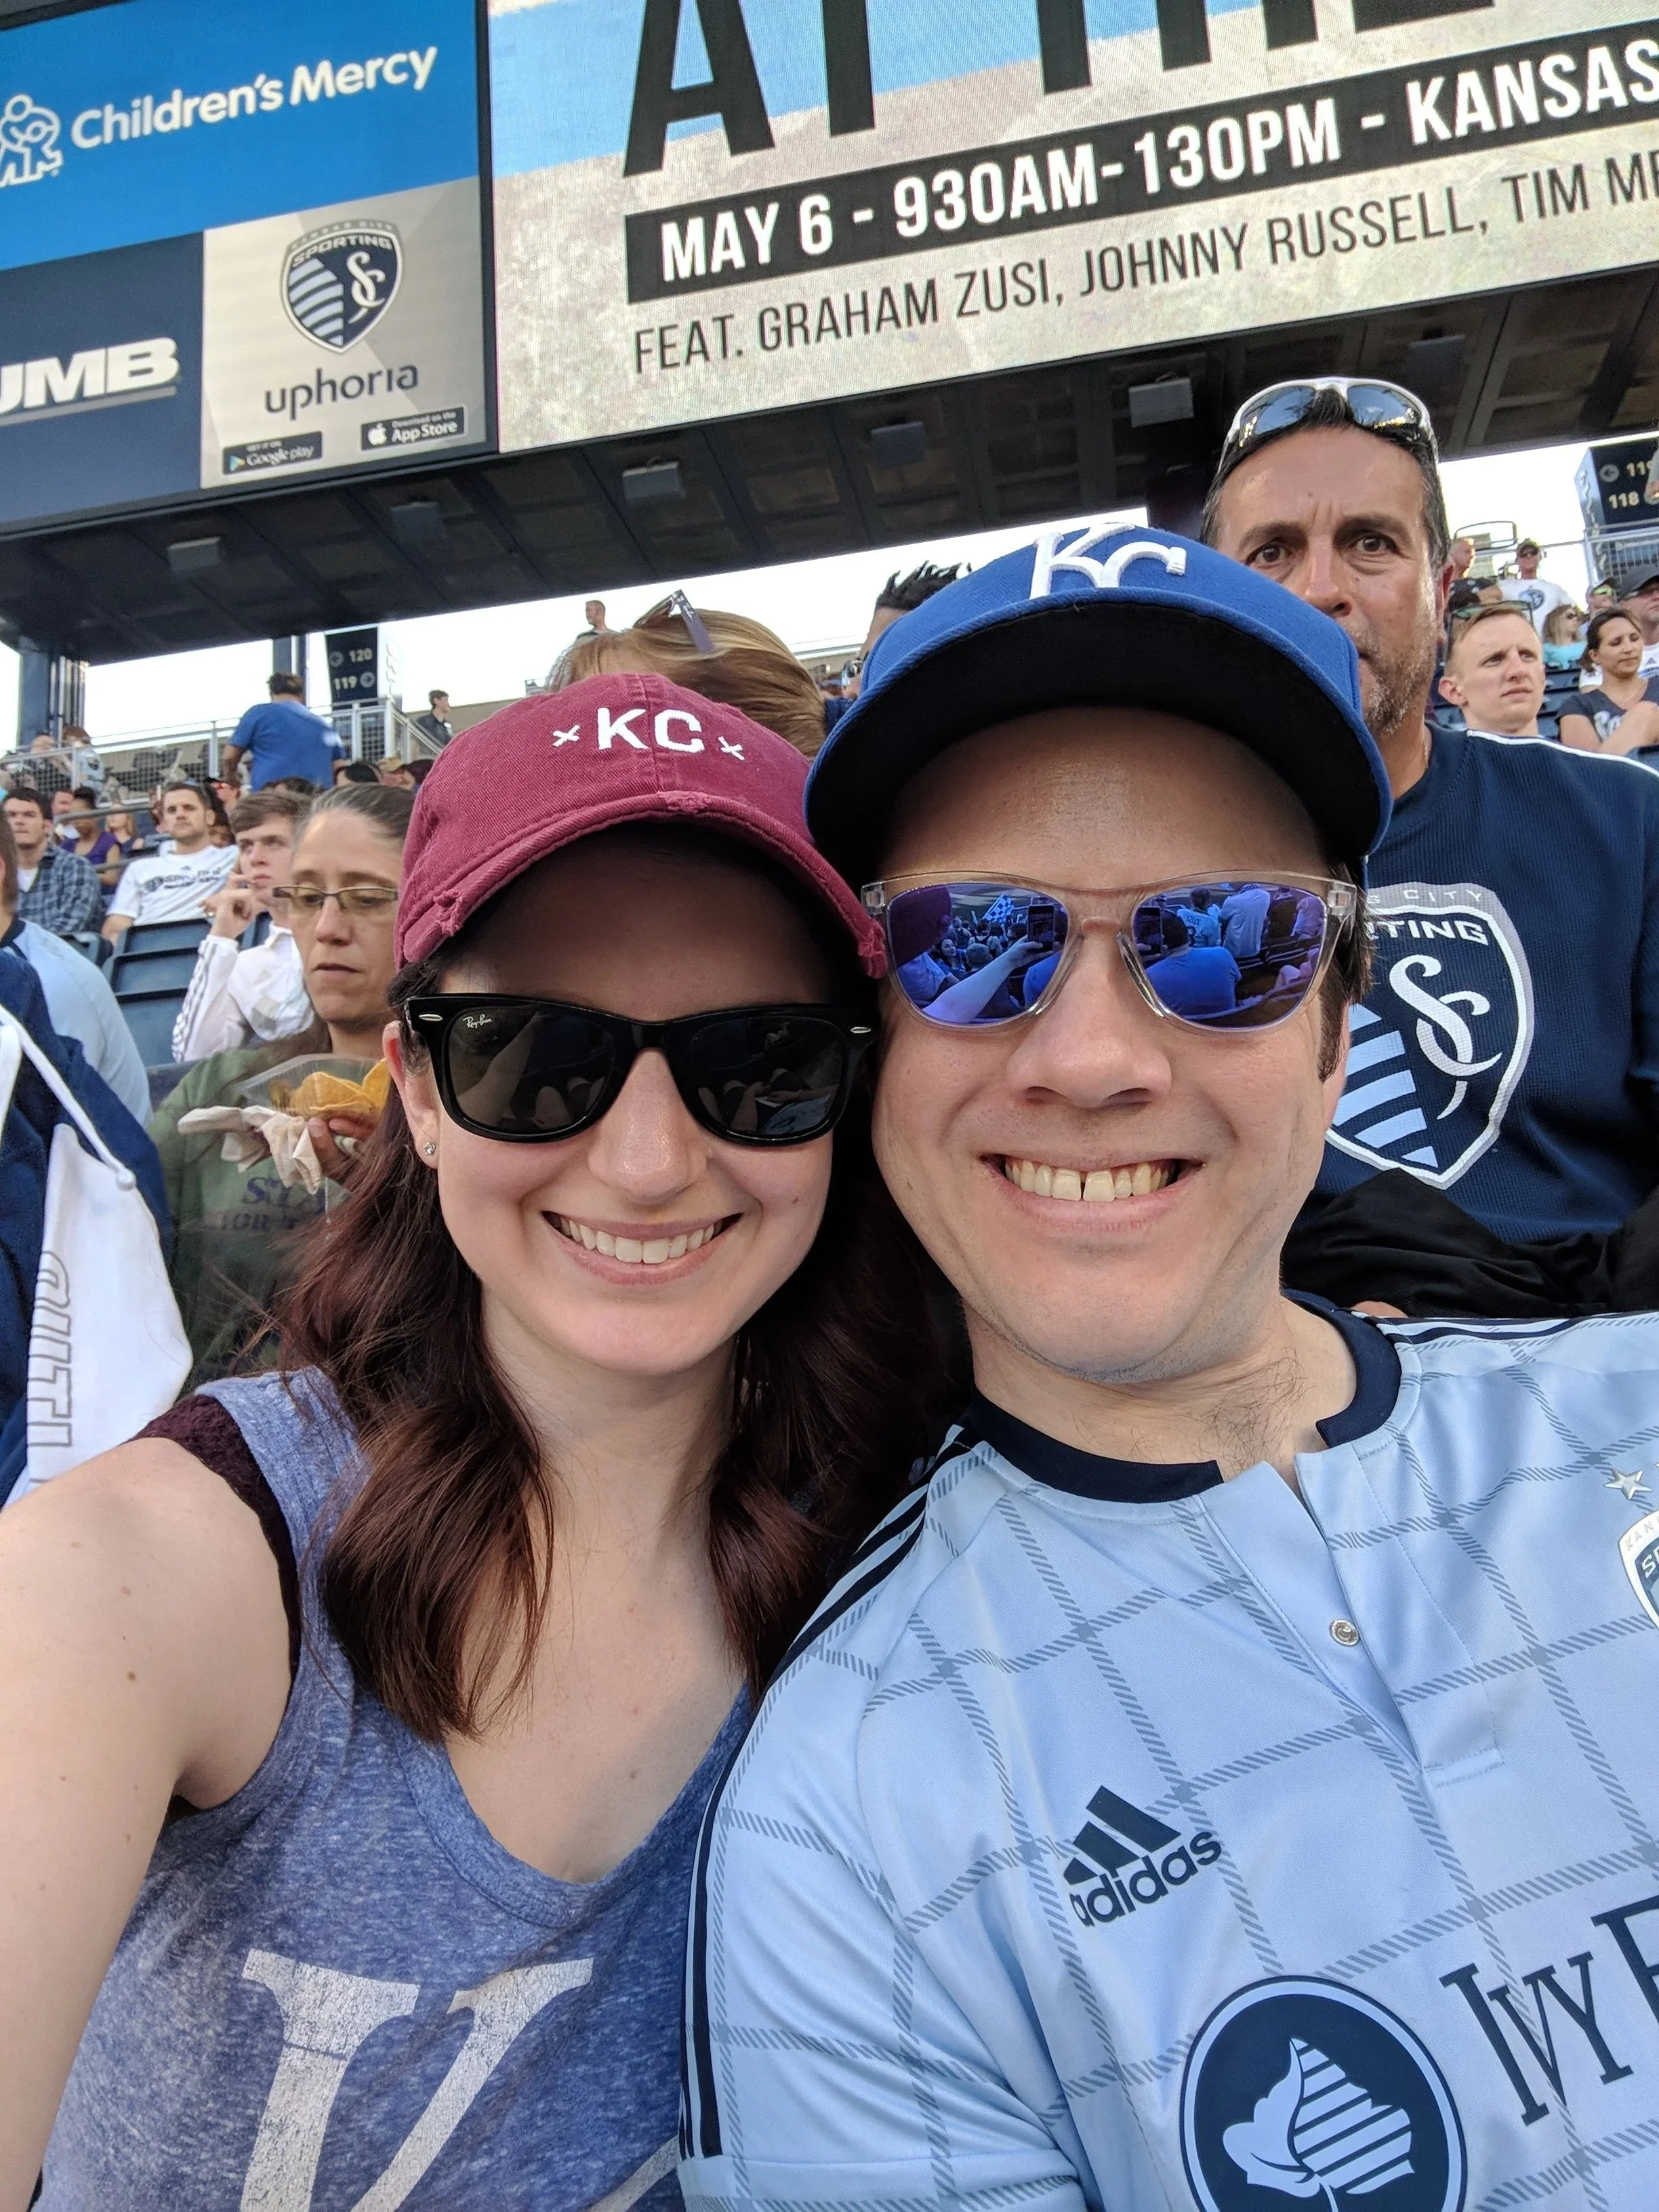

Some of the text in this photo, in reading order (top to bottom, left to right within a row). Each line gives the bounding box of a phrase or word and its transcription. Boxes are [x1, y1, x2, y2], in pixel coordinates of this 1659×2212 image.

[71, 46, 438, 149] Children's Mercy
[661, 203, 779, 282] MAY
[799, 194, 833, 256] 6
[1406, 39, 1659, 146] KANSAS
[292, 235, 392, 267] SPORTING
[634, 314, 743, 373] FEAT.
[758, 279, 939, 351] GRAHAM
[954, 259, 1063, 318] ZUSI,
[1079, 223, 1248, 296] JOHNNY
[1266, 186, 1489, 265] RUSSELL,
[1501, 164, 1589, 224] TIM
[265, 365, 419, 420] uphoria
[392, 422, 458, 443] App Store
[247, 448, 289, 466] Google
[1609, 491, 1639, 509] 118
[349, 648, 373, 663] 120
[334, 676, 358, 690] 119
[597, 708, 705, 753] KC
[1404, 888, 1482, 903] CITY
[462, 1013, 492, 1029] Ray-Ban
[1069, 1831, 1222, 1927] adidas
